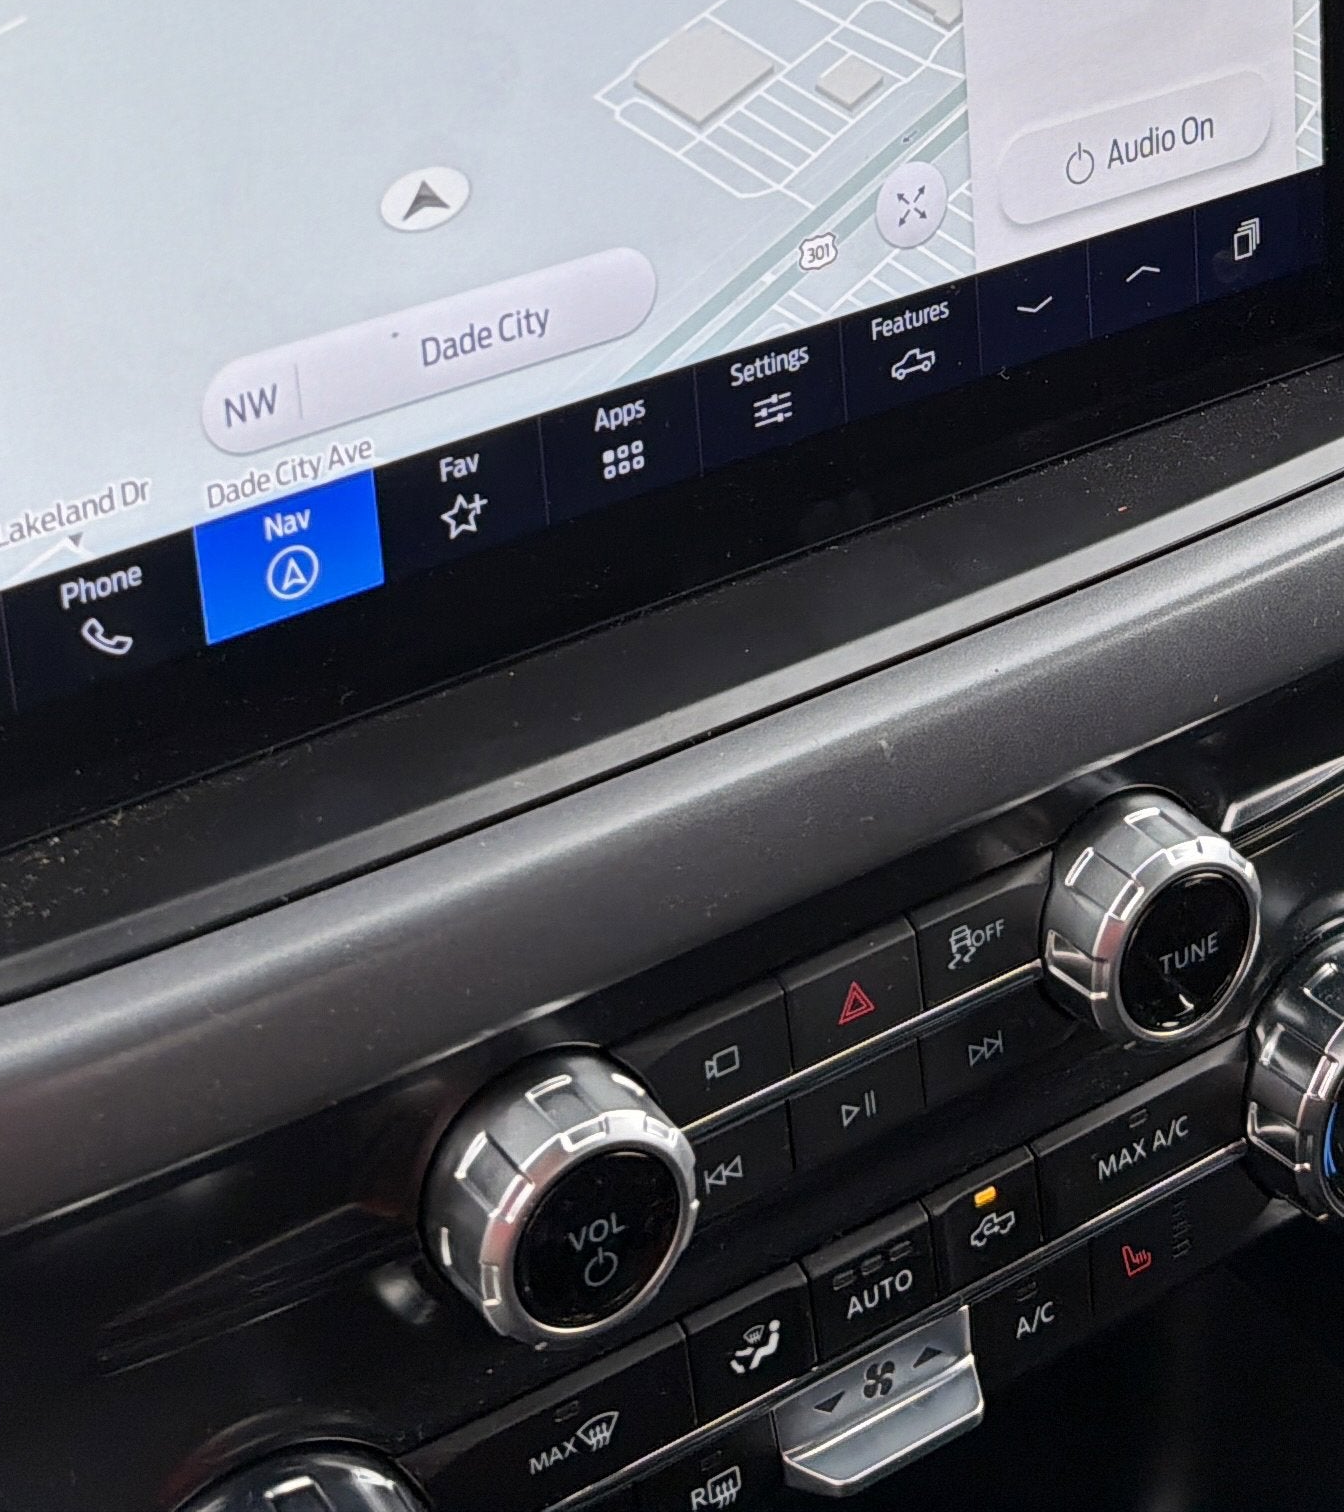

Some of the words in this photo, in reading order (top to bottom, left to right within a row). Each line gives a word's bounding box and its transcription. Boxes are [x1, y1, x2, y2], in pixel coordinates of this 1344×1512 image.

[1106, 130, 1177, 170] Audio
[1181, 115, 1215, 145] On
[806, 242, 832, 262] 301
[420, 324, 492, 367] Dade
[498, 305, 551, 350] City
[871, 300, 950, 341] Features
[730, 344, 809, 388] Settings
[223, 383, 279, 428] NW
[594, 398, 646, 432] Apps
[206, 473, 273, 509] Dade
[275, 455, 323, 493] City
[327, 438, 374, 471] Ave
[440, 452, 481, 482] Fav
[120, 480, 151, 512] Dr
[264, 509, 312, 541] Nav
[61, 565, 143, 609] Phone
[971, 918, 1005, 947] OFF
[1160, 932, 1219, 976] TUNE
[1098, 1140, 1147, 1180] MAX
[1152, 1115, 1189, 1152] A/C
[567, 1212, 626, 1252] VOL
[846, 1269, 913, 1320] AUTO
[1016, 1302, 1054, 1340] A/C
[529, 1437, 578, 1475] MAX
[691, 1488, 706, 1509] R
